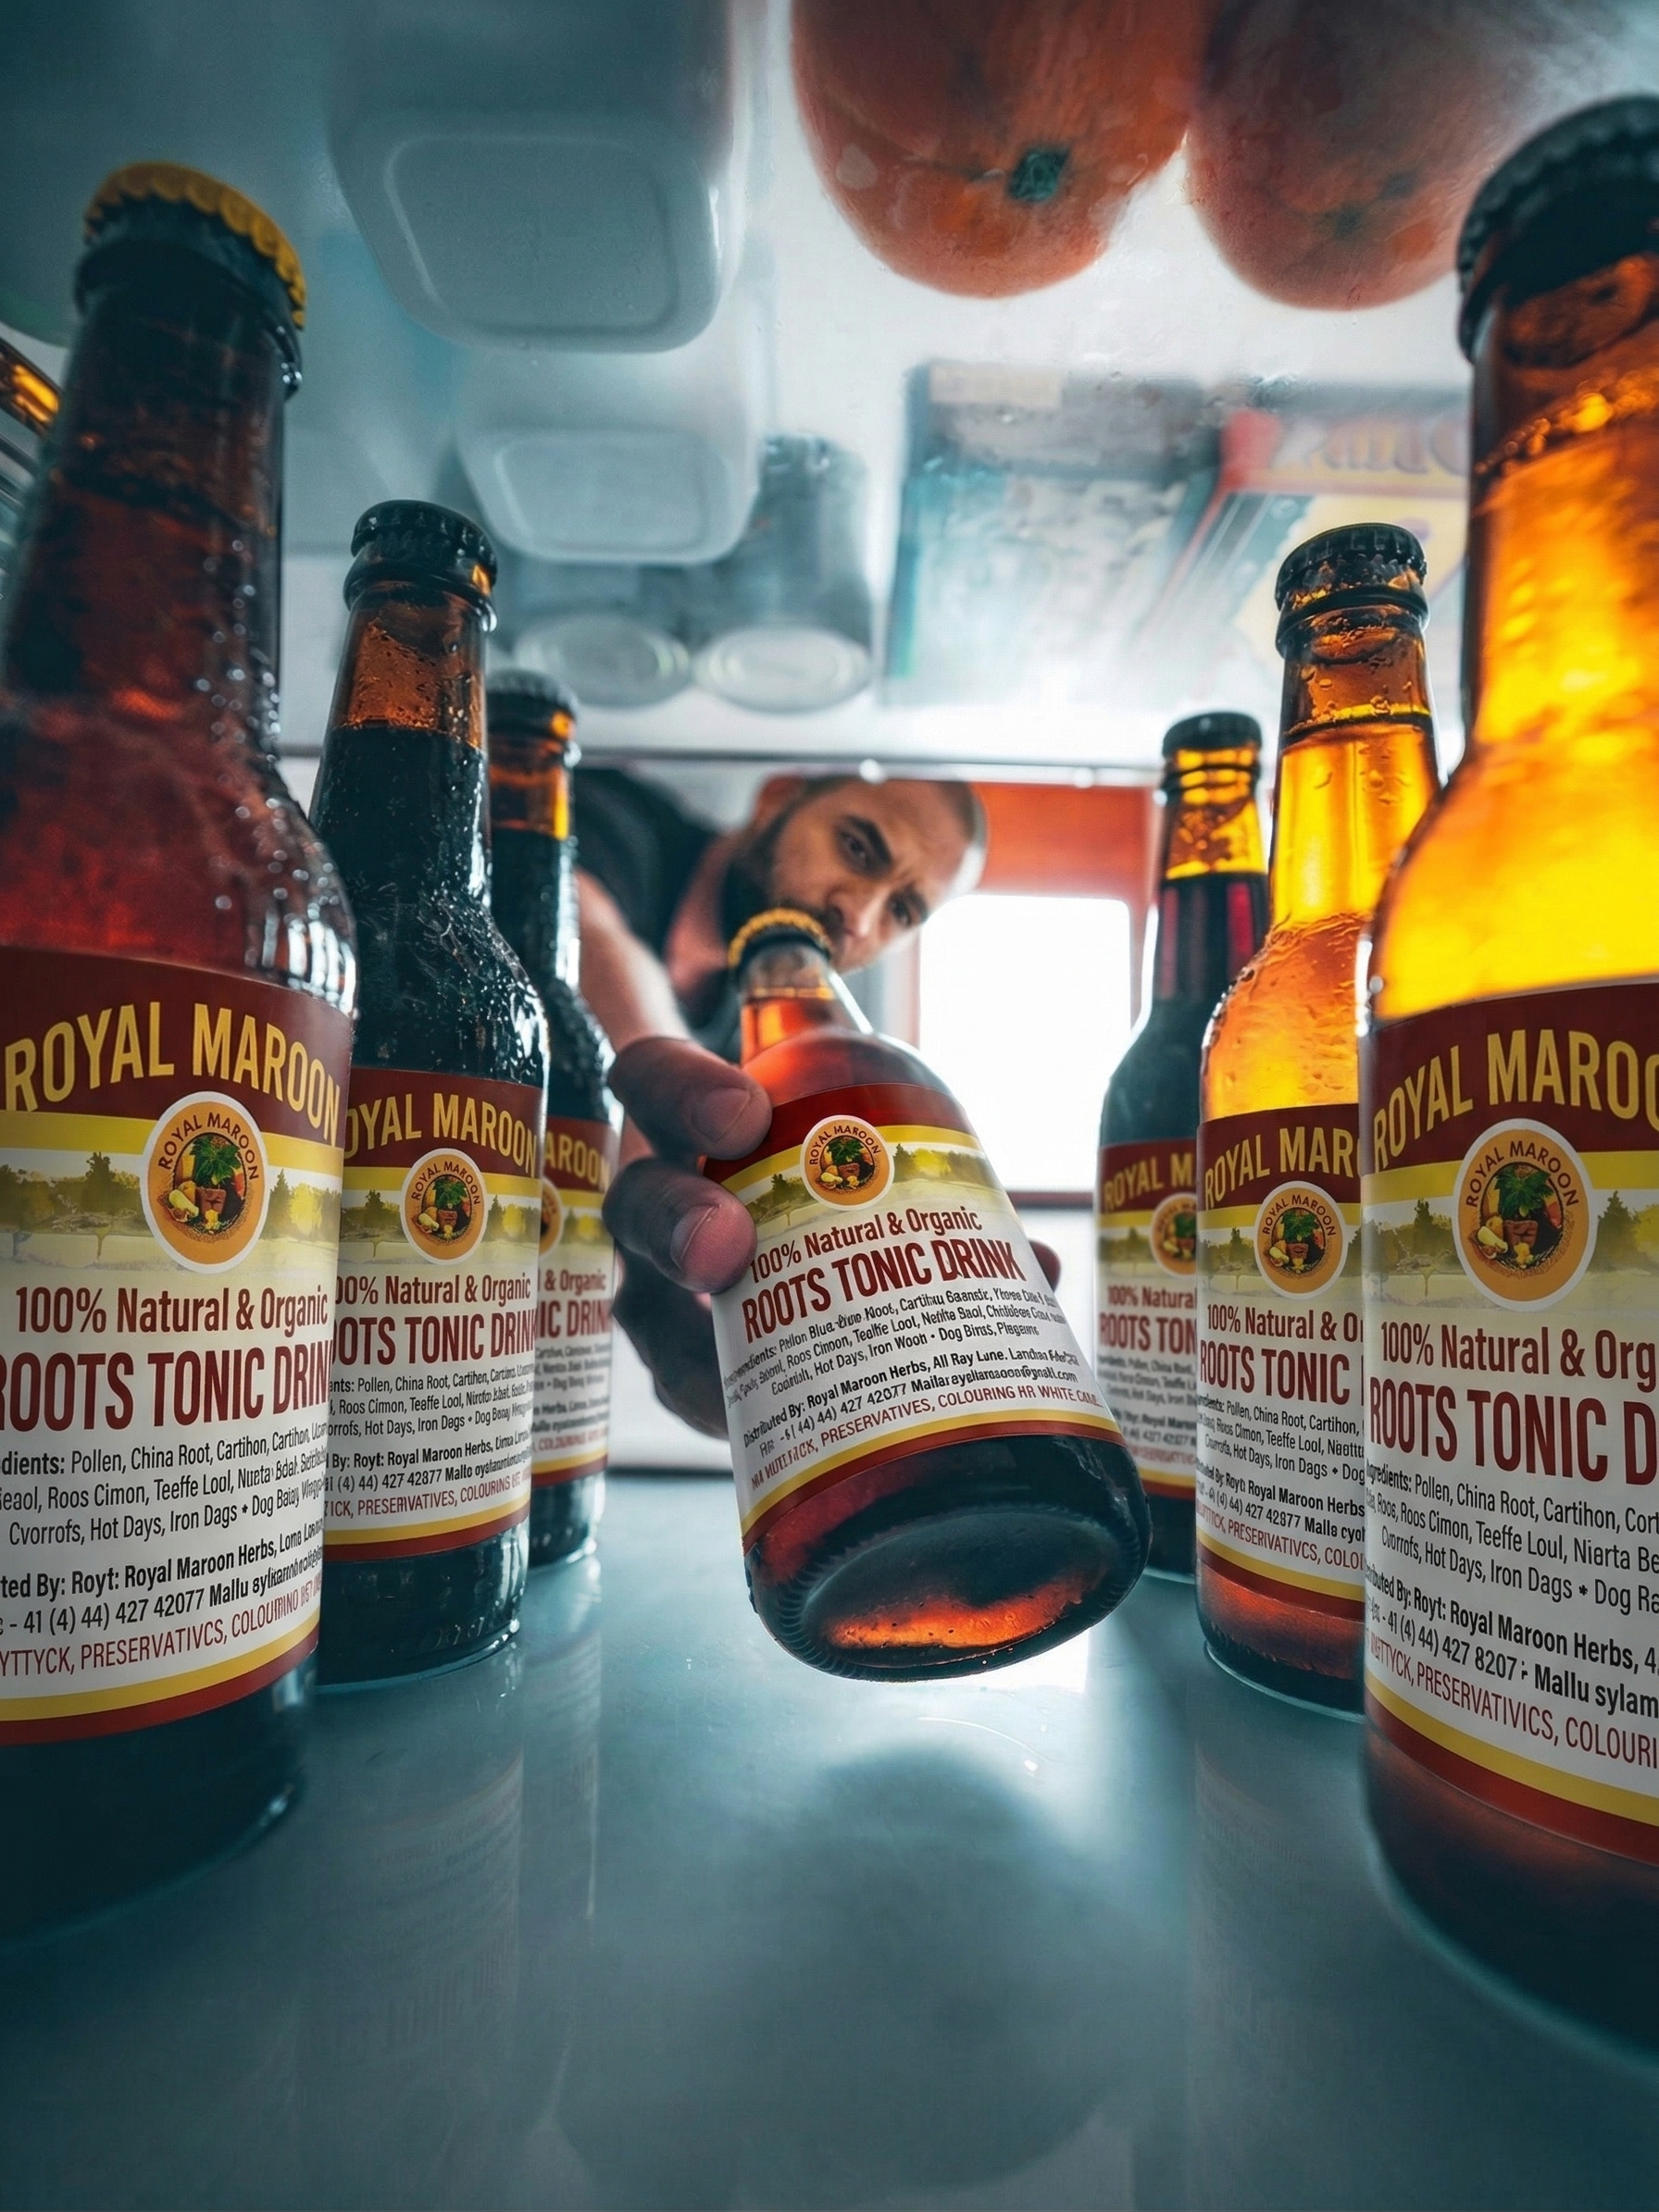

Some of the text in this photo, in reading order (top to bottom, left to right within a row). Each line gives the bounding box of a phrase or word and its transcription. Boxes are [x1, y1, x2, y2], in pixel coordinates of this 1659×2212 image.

[5, 1001, 341, 1147] ROYAL MAROON
[1374, 1045, 1473, 1174] ROYAL
[158, 1112, 259, 1181] ROYAL MAROON
[433, 1093, 537, 1178] MAROON
[809, 1125, 881, 1165] ROYAL MAROON
[411, 1161, 481, 1205] ROYAL MAROON
[1104, 1156, 1164, 1212] ROYAL
[1205, 1135, 1270, 1211] ROYAL
[1466, 1140, 1578, 1208] ROYAL MAROON
[1263, 1194, 1336, 1236] ROYAL MAROON
[750, 1206, 982, 1284] 100% Natural & Organic
[385, 1272, 530, 1307] Natural & Organic
[544, 1268, 606, 1296] & Organic
[742, 1267, 831, 1344] ROOTS
[831, 1242, 932, 1302] TONIC
[930, 1237, 1027, 1282] DRINK
[17, 1285, 329, 1338] 100% Natural & Organic
[1099, 1311, 1152, 1351] ROOTS
[1207, 1303, 1338, 1341] 100% Natural &
[405, 1313, 484, 1364] TONIC
[786, 1349, 812, 1369] Roos
[814, 1326, 964, 1376] Hot Days, Iron Dog
[1381, 1322, 1434, 1366] 100%
[1441, 1324, 1550, 1374] Natural
[1560, 1328, 1585, 1377] &
[0, 1352, 134, 1432] OOTS
[148, 1347, 265, 1426] TONIC
[358, 1374, 451, 1394] Pollen, China Root,
[788, 1401, 805, 1419] By:
[807, 1384, 839, 1410] Royal
[840, 1371, 888, 1396] Maroon
[889, 1361, 931, 1380] Herbs,
[933, 1353, 949, 1370] All
[950, 1352, 974, 1368] Ray
[1201, 1339, 1351, 1406] ROOTS TONIC
[339, 1399, 365, 1414] Roos
[365, 1421, 383, 1435] Hot
[387, 1419, 415, 1437] Days,
[418, 1417, 438, 1432] Iron
[442, 1415, 465, 1432] Dags
[475, 1410, 491, 1426] Dog
[820, 1398, 936, 1448] PRESERVATIVES,
[938, 1385, 1016, 1409] COLOURING
[1037, 1385, 1077, 1402] WHITE
[840, 1395, 862, 1415] 427
[1254, 1405, 1360, 1437] China Root, Cartihon,
[1370, 1376, 1457, 1462] ROOTS
[1467, 1389, 1608, 1482] TONIC
[71, 1435, 270, 1474] Pollen, China Root, Cartihon,
[332, 1453, 350, 1473] By:
[354, 1452, 384, 1472] Royt:
[388, 1448, 418, 1469] Royal
[422, 1446, 462, 1463] Maroon
[465, 1439, 493, 1457] Herbs,
[1233, 1443, 1247, 1461] Hot
[1249, 1447, 1273, 1470] Days,
[1276, 1453, 1295, 1473] Iron
[1299, 1457, 1328, 1481] Dags
[1266, 1428, 1295, 1449] Teeffe
[48, 1475, 198, 1510] Roos Cimon, Teeffe
[1245, 1502, 1264, 1521] 427
[1248, 1479, 1366, 1518] Royal Maroon Herbs
[1416, 1473, 1620, 1535] Pollen, China Root, Cartihon,
[9, 1495, 273, 1546] Cvorrofs, Hot Days, Iron Dags Dog
[1401, 1501, 1426, 1529] Roos
[1429, 1510, 1472, 1545] Cimon,
[1476, 1521, 1522, 1552] Teeffe
[37, 1573, 66, 1602] By:
[72, 1567, 119, 1598] Royt:
[125, 1558, 171, 1591] Royal
[177, 1551, 234, 1581] Maroon
[238, 1538, 277, 1567] Herbs,
[1426, 1541, 1631, 1616] Hot Days, Iron Dags Dog
[23, 1609, 42, 1634] 41
[50, 1606, 76, 1635] (4)
[81, 1602, 109, 1631] 44)
[115, 1598, 149, 1623] 427
[209, 1578, 248, 1607] Mallu
[1396, 1579, 1411, 1609] By:
[1451, 1600, 1492, 1636] Royal
[1498, 1613, 1567, 1656] Maroon
[1574, 1632, 1639, 1675] Herbs,
[1441, 1635, 1470, 1666] 427
[1535, 1663, 1589, 1703] Mallu
